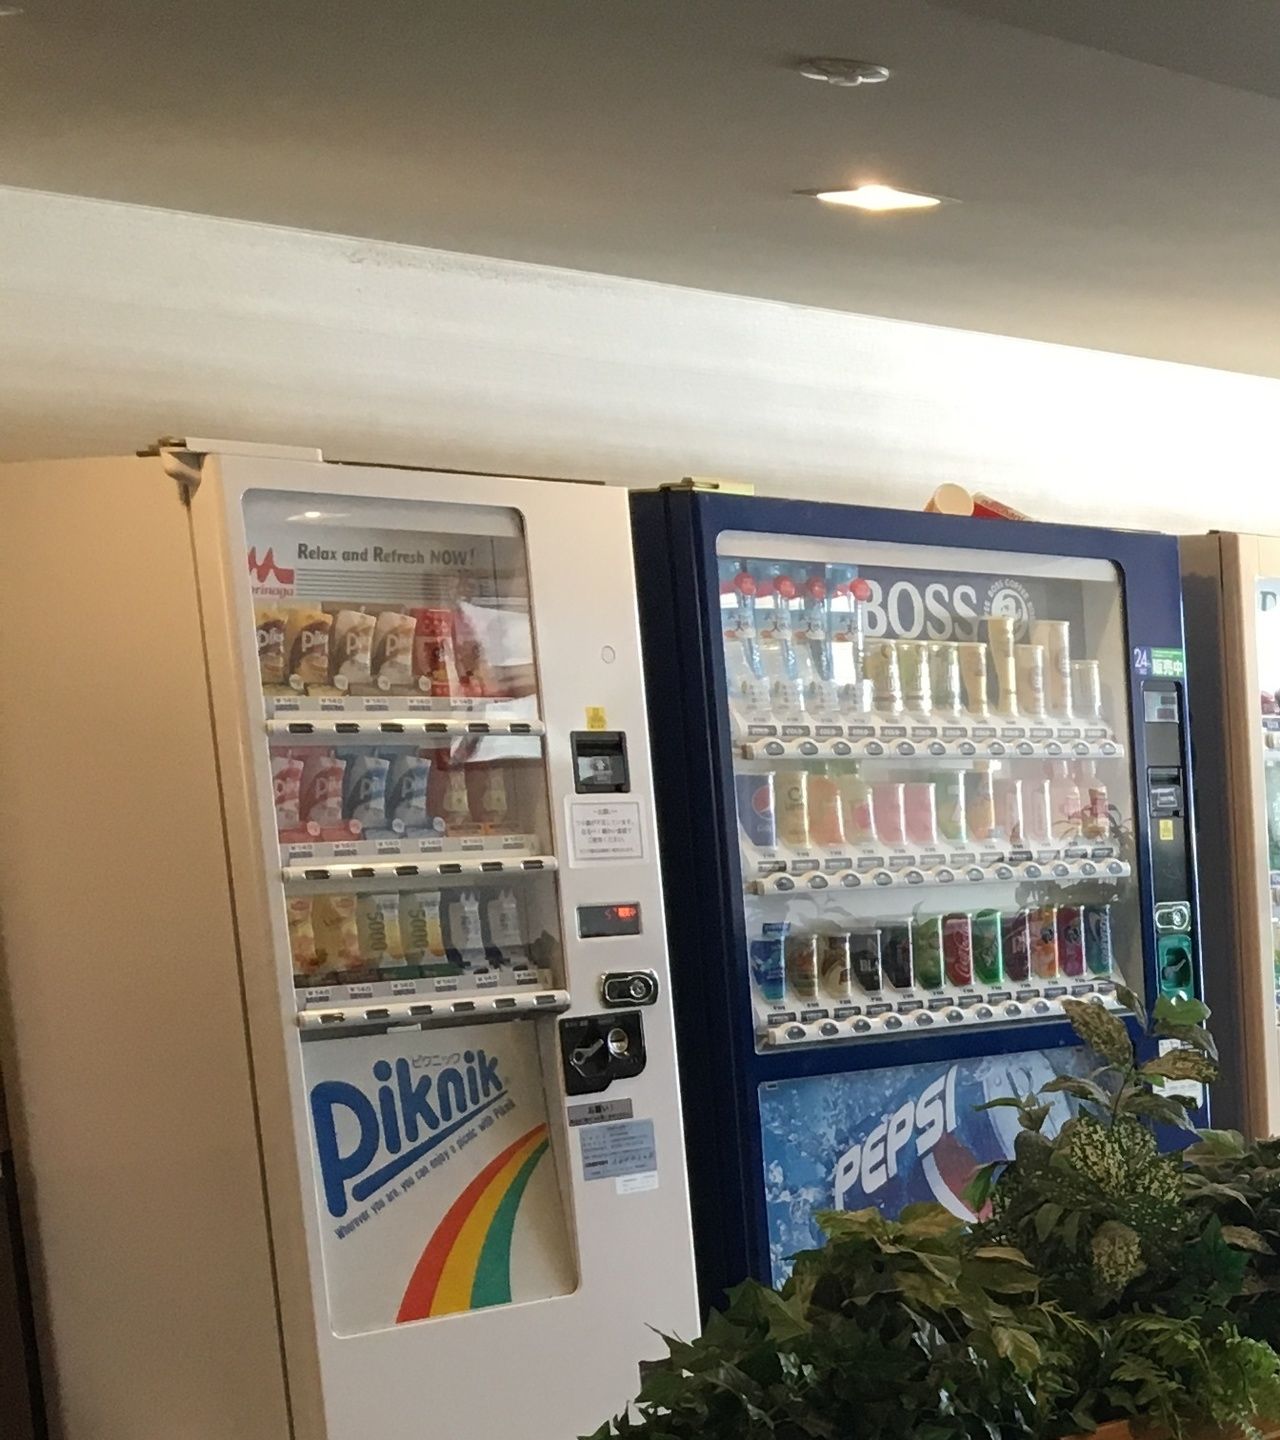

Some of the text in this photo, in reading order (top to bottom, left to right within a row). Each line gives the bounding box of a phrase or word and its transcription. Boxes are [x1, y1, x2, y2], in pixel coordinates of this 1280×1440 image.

[297, 543, 475, 566] Relax and Refresh NOW!
[861, 579, 979, 643] BOSS
[1134, 648, 1148, 668] 24
[411, 1052, 462, 1069] ピクニック
[310, 1049, 503, 1217] Piknik
[834, 1064, 958, 1211] PEPSI
[334, 1210, 371, 1239] Wherever
[371, 1199, 386, 1214] you
[401, 1176, 415, 1192] you
[415, 1165, 430, 1180] can
[429, 1151, 450, 1169] enjoy
[456, 1128, 478, 1150] picnic
[478, 1115, 494, 1132] with
